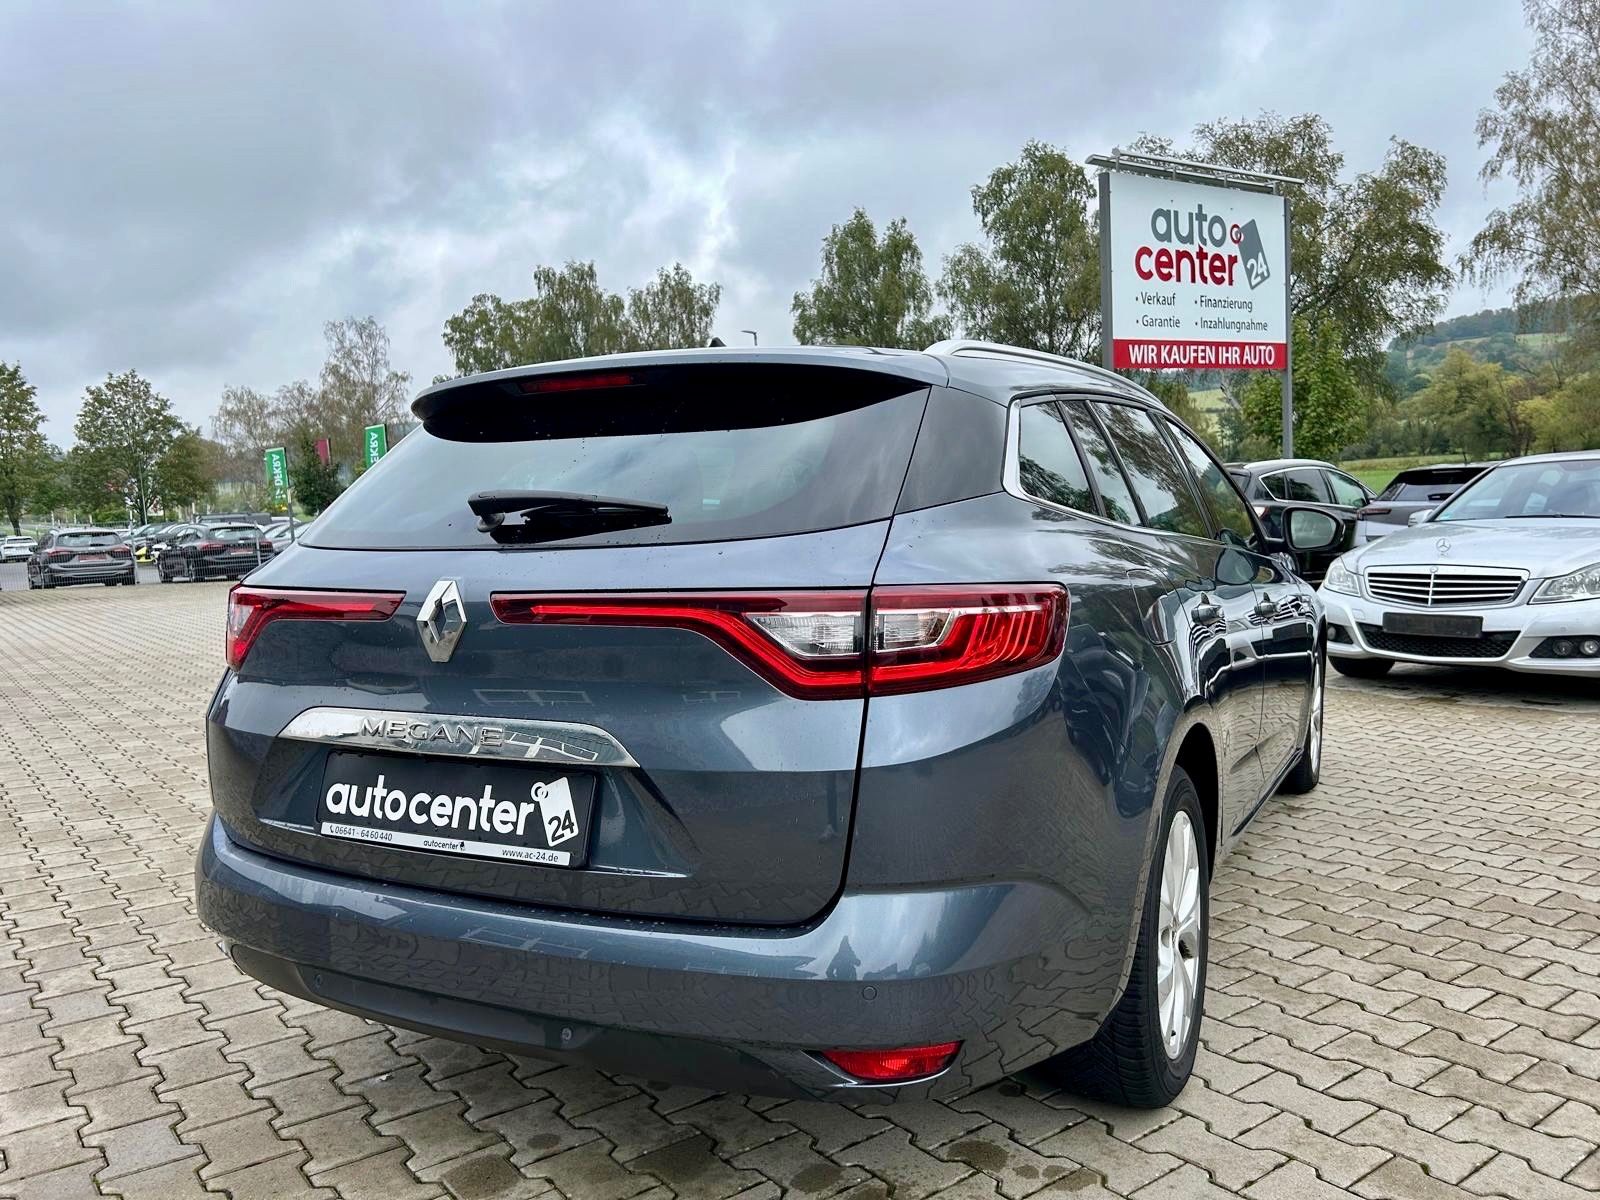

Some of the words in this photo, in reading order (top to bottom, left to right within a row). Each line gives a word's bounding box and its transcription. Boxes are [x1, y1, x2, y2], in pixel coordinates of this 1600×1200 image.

[1151, 204, 1227, 247] auto
[1135, 245, 1238, 286] center
[1247, 252, 1268, 283] 24
[1140, 292, 1176, 306] Verkauf
[1199, 295, 1253, 312] Finanzierung
[1141, 315, 1181, 328] Garantie
[1200, 319, 1268, 332] Inzahlungnahme
[1128, 344, 1157, 363] WIR
[1160, 345, 1215, 364] KAUFEN
[1218, 347, 1241, 364] IHR
[1243, 346, 1275, 365] AUTO
[361, 718, 503, 747] MEGANE
[325, 774, 535, 836] autocenter
[335, 826, 355, 836] 06641
[547, 811, 575, 841] 24
[423, 840, 459, 850] autocenter
[502, 848, 559, 862] www.ac-24.de
